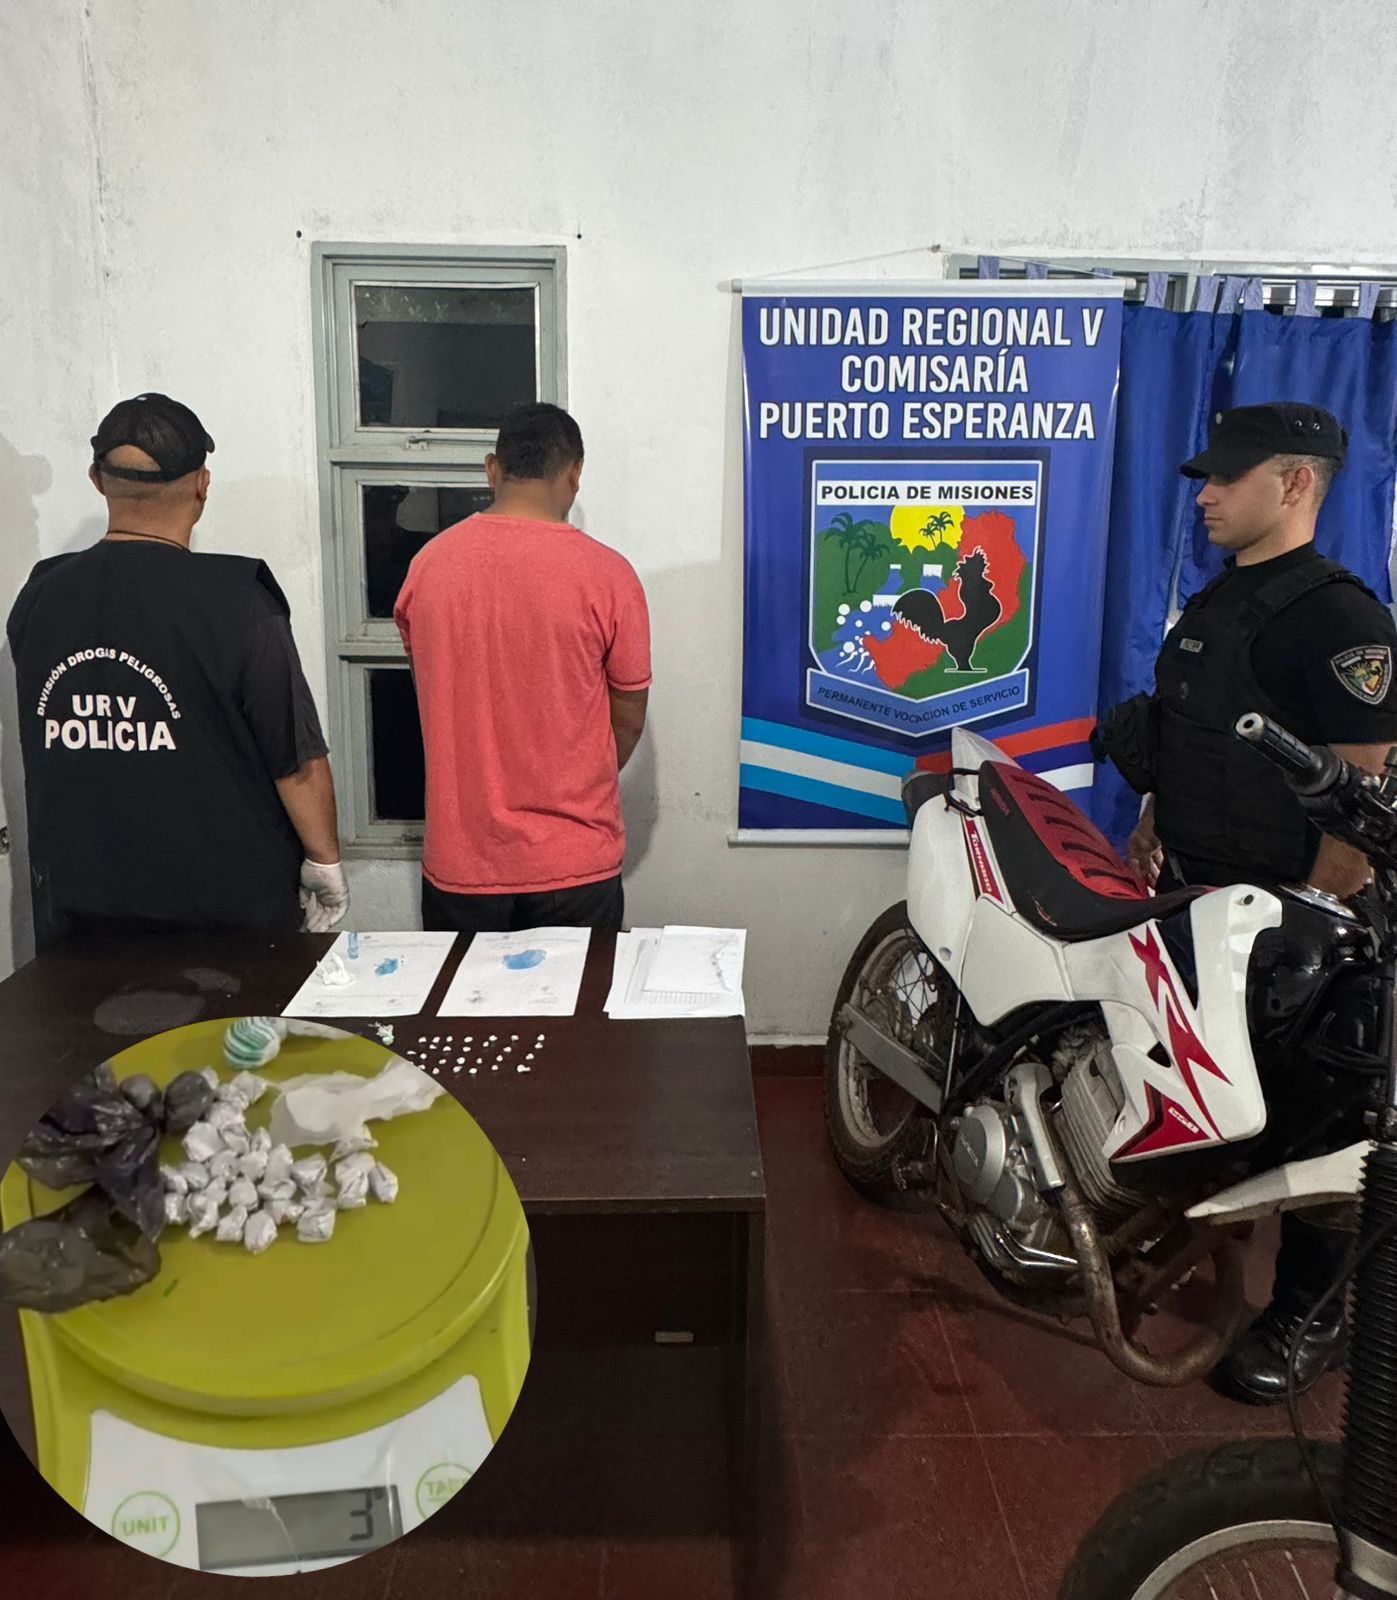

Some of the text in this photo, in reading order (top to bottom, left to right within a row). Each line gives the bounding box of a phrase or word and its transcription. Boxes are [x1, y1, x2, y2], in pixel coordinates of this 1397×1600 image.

[759, 307, 1104, 346] UNIDAD REGIONAL V
[841, 349, 1029, 393] COMISARÍA
[759, 402, 1095, 440] PUERTO ESPERANZA
[821, 485, 1034, 500] POLICIA DE MISIONES
[119, 651, 181, 720] PELIGROSAS
[817, 686, 1021, 725] PERMANENTE VOCACION DE SERVICIO
[45, 719, 176, 752] POLICIA
[122, 1516, 169, 1536] UNIT
